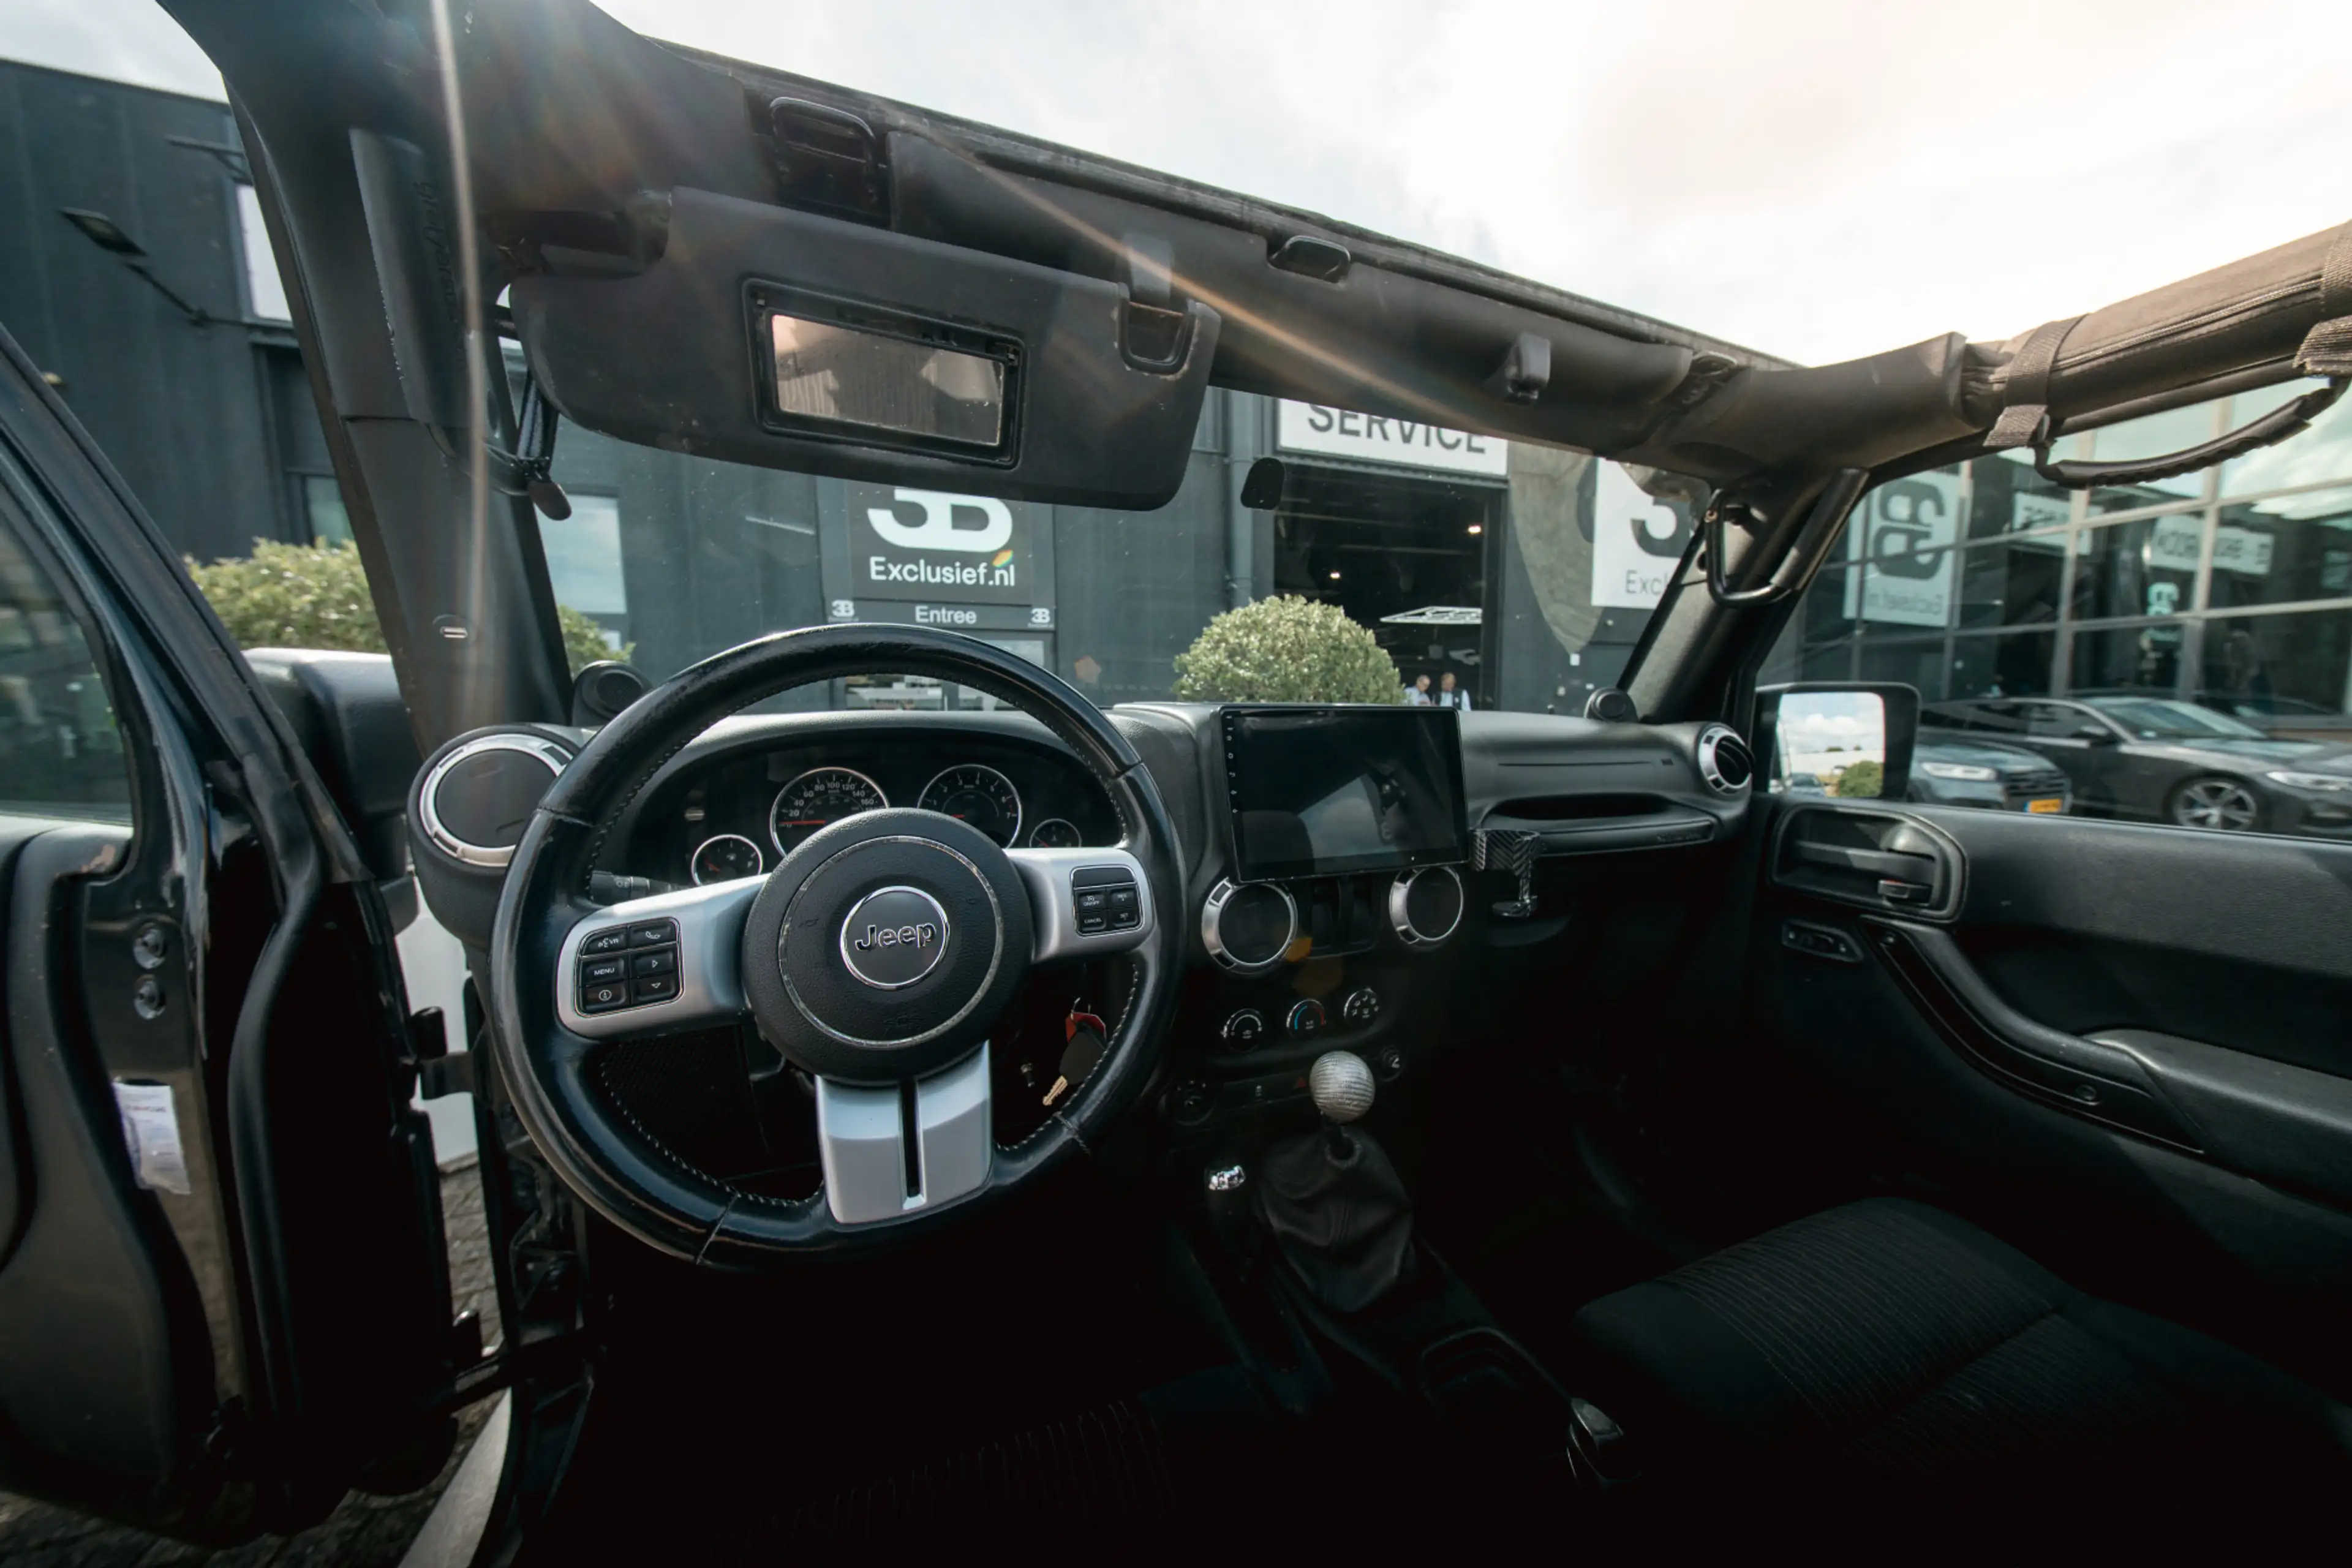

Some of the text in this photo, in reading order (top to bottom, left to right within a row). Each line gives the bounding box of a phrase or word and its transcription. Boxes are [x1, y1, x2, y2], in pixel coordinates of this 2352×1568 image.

[1308, 402, 1485, 454] SERVICE
[869, 556, 1016, 587] Exclusief.nl
[1625, 569, 1669, 596] Excl
[914, 605, 978, 625] Entree
[854, 922, 937, 951] Jeep
[594, 967, 615, 976] MENU
